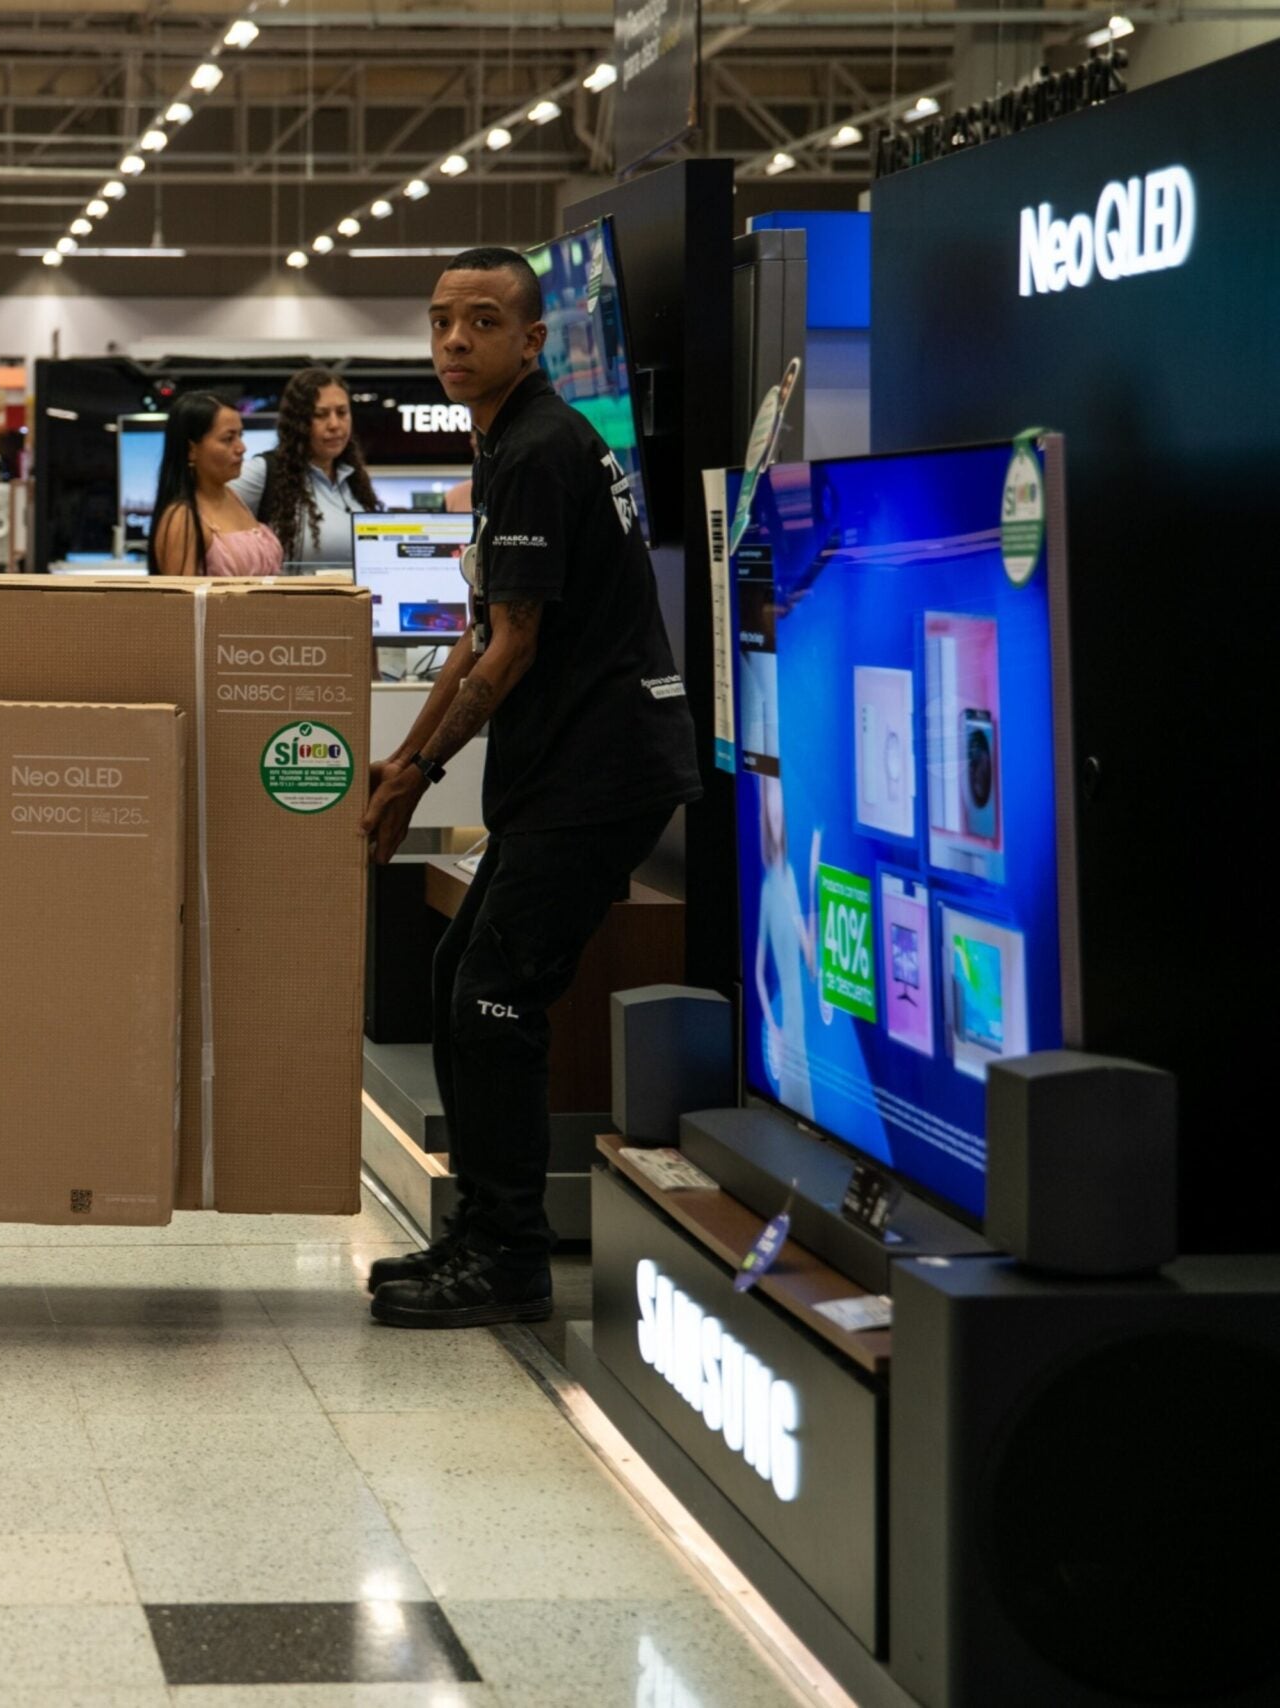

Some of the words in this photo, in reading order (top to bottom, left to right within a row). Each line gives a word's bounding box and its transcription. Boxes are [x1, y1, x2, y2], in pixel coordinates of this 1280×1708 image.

[1019, 202, 1094, 297] Neo
[1094, 163, 1196, 281] QLED
[217, 645, 265, 666] Neo
[269, 646, 327, 667] QLED
[217, 684, 286, 701] QN85C
[274, 737, 299, 766] SÍ
[11, 765, 60, 787] Neo
[64, 766, 123, 788] QLED
[11, 806, 81, 823] QN90C
[824, 900, 870, 979] 40%
[477, 1000, 519, 1019] TCL
[636, 1259, 799, 1501] SAMSUNG
